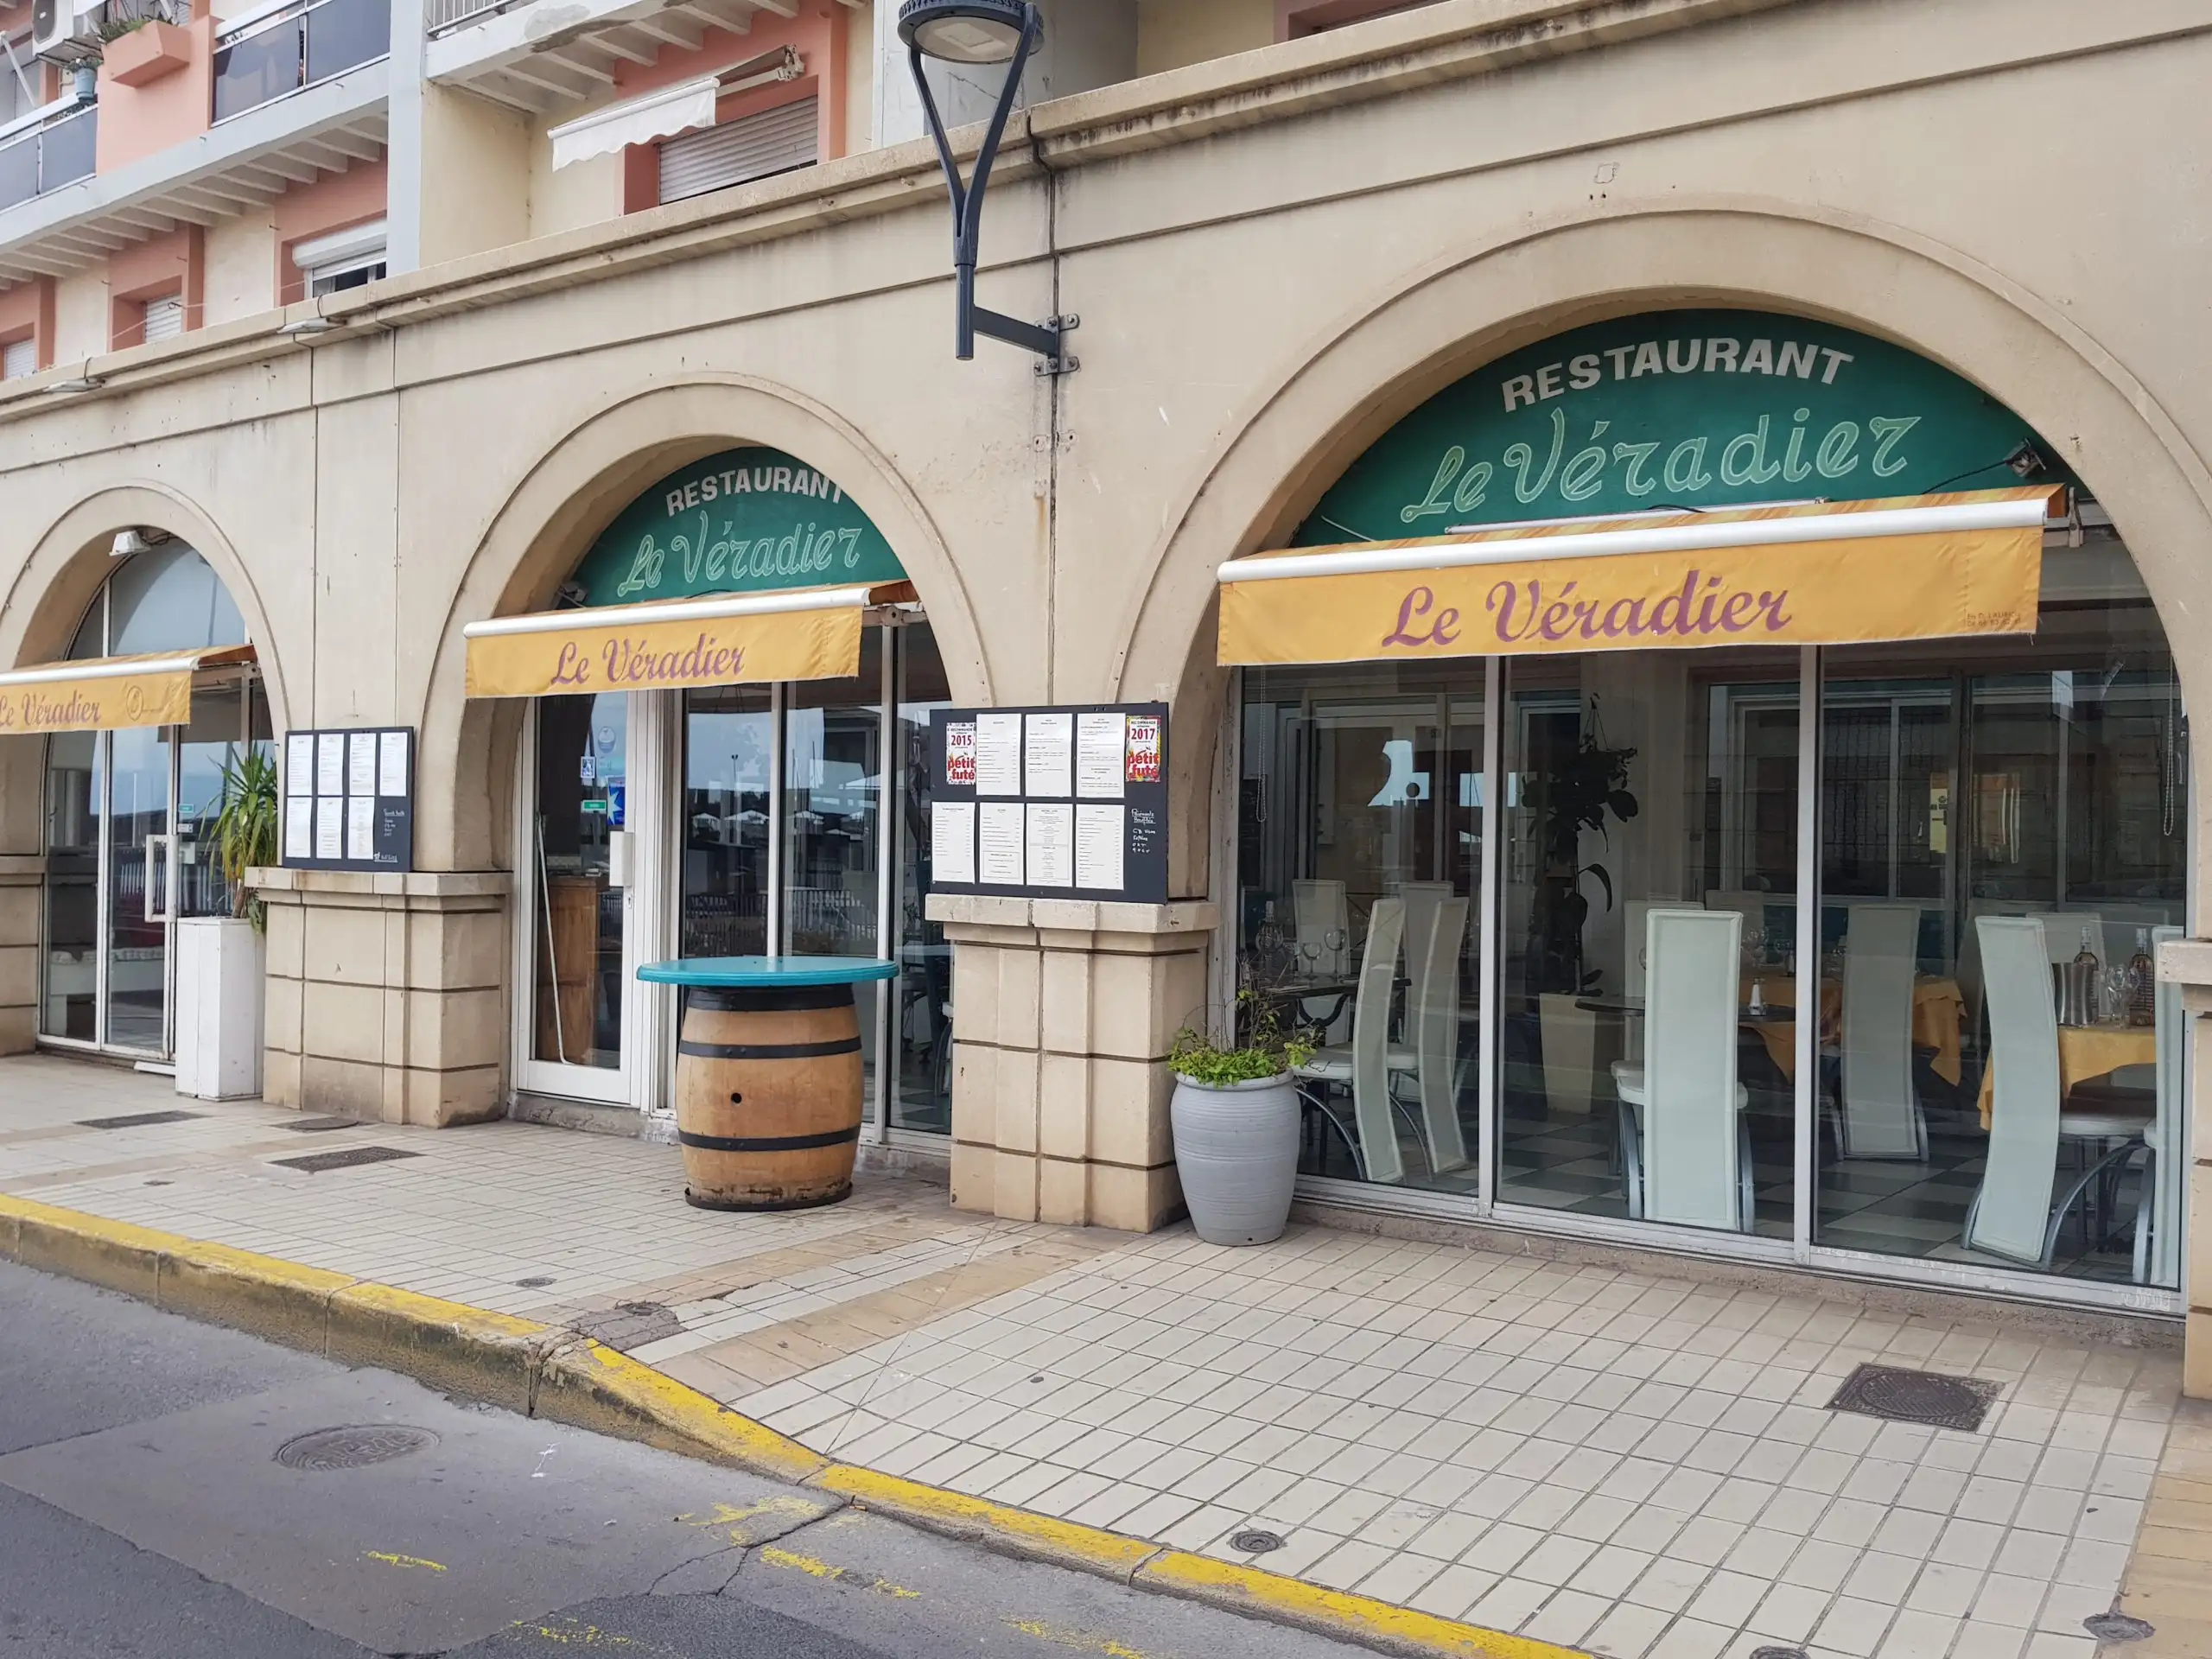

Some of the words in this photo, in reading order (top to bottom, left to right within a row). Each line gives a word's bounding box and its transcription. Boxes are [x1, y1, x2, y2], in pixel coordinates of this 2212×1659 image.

[1502, 339, 1854, 412] RESTAURANT
[1400, 445, 1493, 523] Le
[1503, 406, 1923, 505] Véradier
[617, 534, 665, 597] Le
[671, 510, 862, 584] Véradier
[1382, 586, 1461, 648] Le
[1485, 569, 1793, 643] Véradier
[551, 641, 590, 685] Le
[602, 632, 747, 683] Véradier
[22, 689, 102, 727] Véradier
[950, 734, 972, 747] 2015
[1131, 728, 1155, 741] 2017
[947, 756, 976, 772] petit
[951, 767, 976, 780] futé
[1127, 751, 1160, 767] petit
